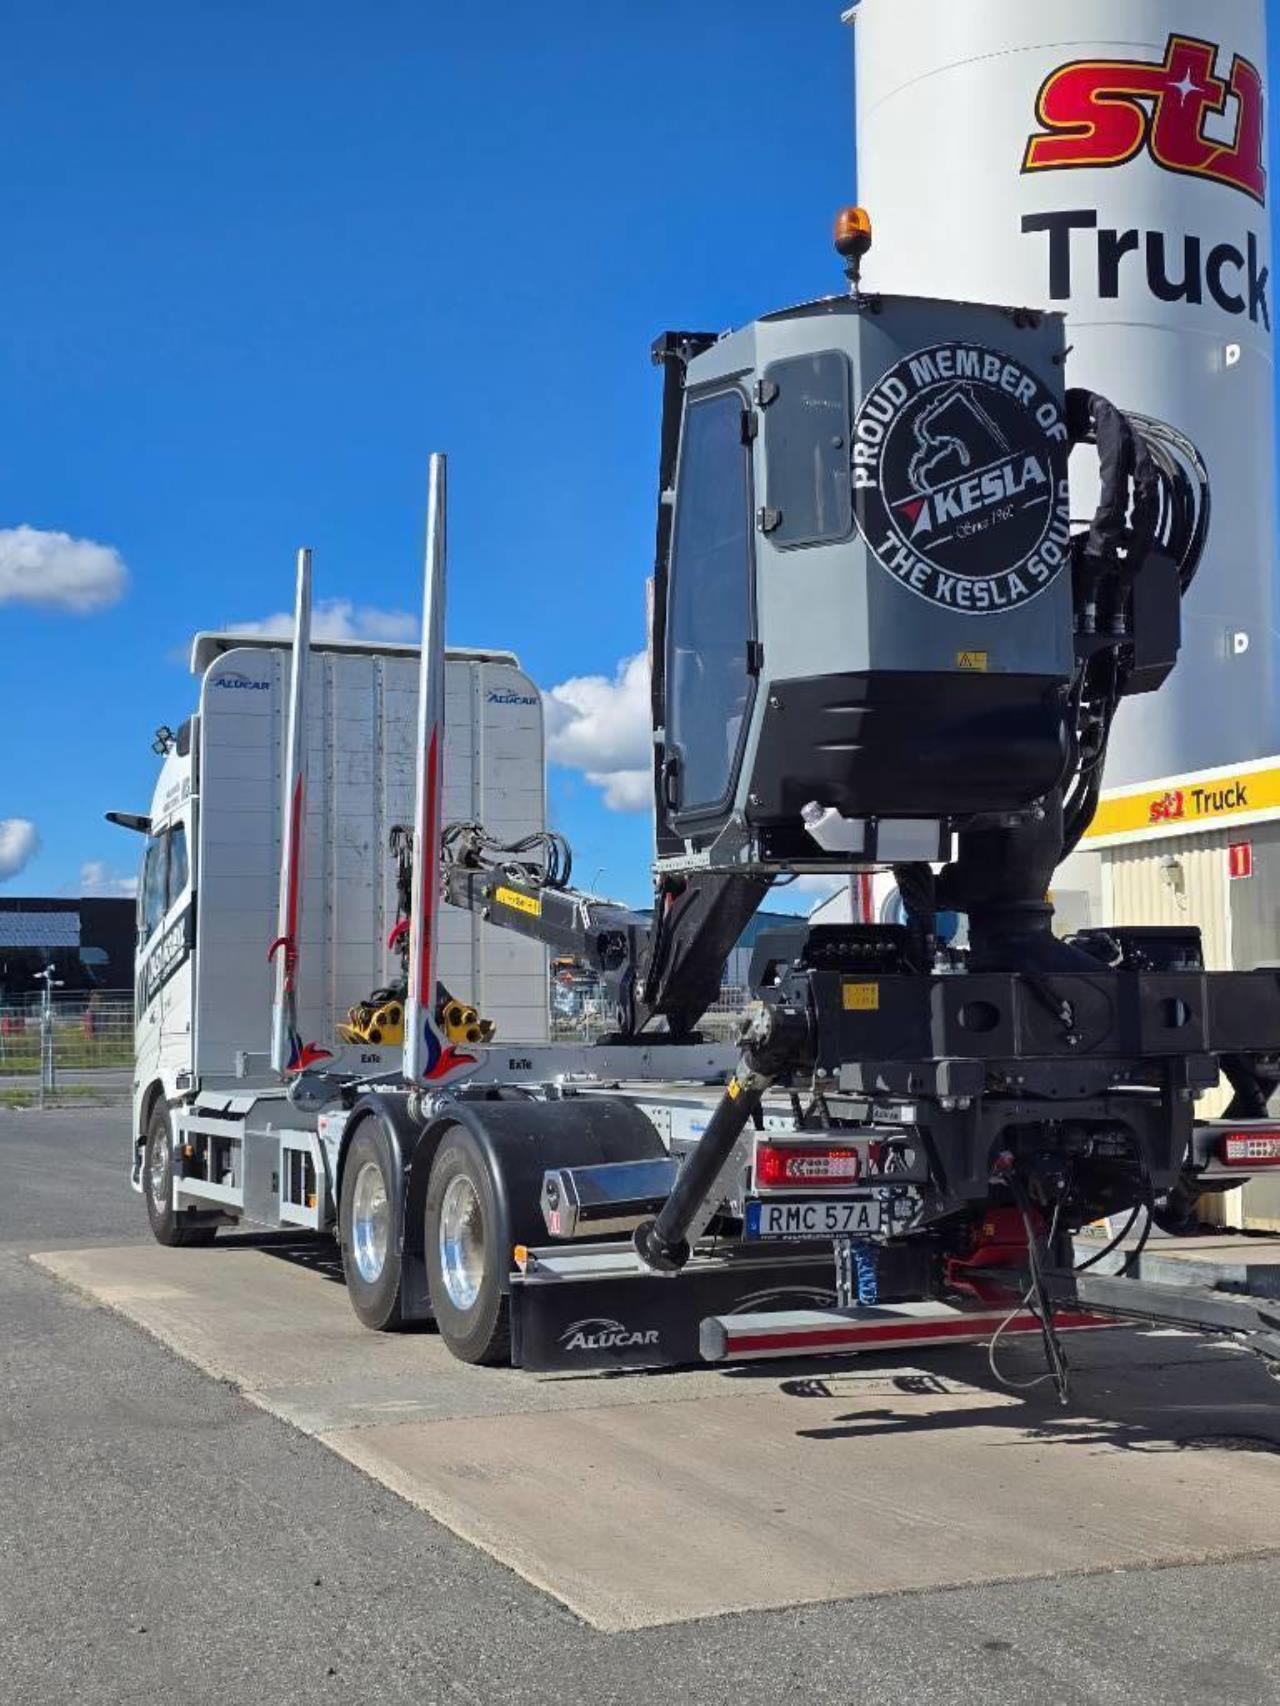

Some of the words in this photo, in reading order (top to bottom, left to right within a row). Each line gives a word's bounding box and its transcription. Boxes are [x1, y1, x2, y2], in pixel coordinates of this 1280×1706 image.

[1020, 33, 1266, 207] st1
[1021, 209, 1270, 332] Truck
[853, 377, 908, 489] PROUD
[909, 349, 1036, 406] MEMBER
[1036, 402, 1068, 441] OF
[932, 455, 1047, 524] KESLA
[877, 530, 932, 588] THE
[934, 573, 1029, 607] KESLA
[1191, 781, 1247, 814] Truck
[509, 1059, 532, 1070] ExTe
[769, 1206, 816, 1231] RMC
[825, 1205, 870, 1230] 57A
[565, 1330, 659, 1350] ALUCAR
